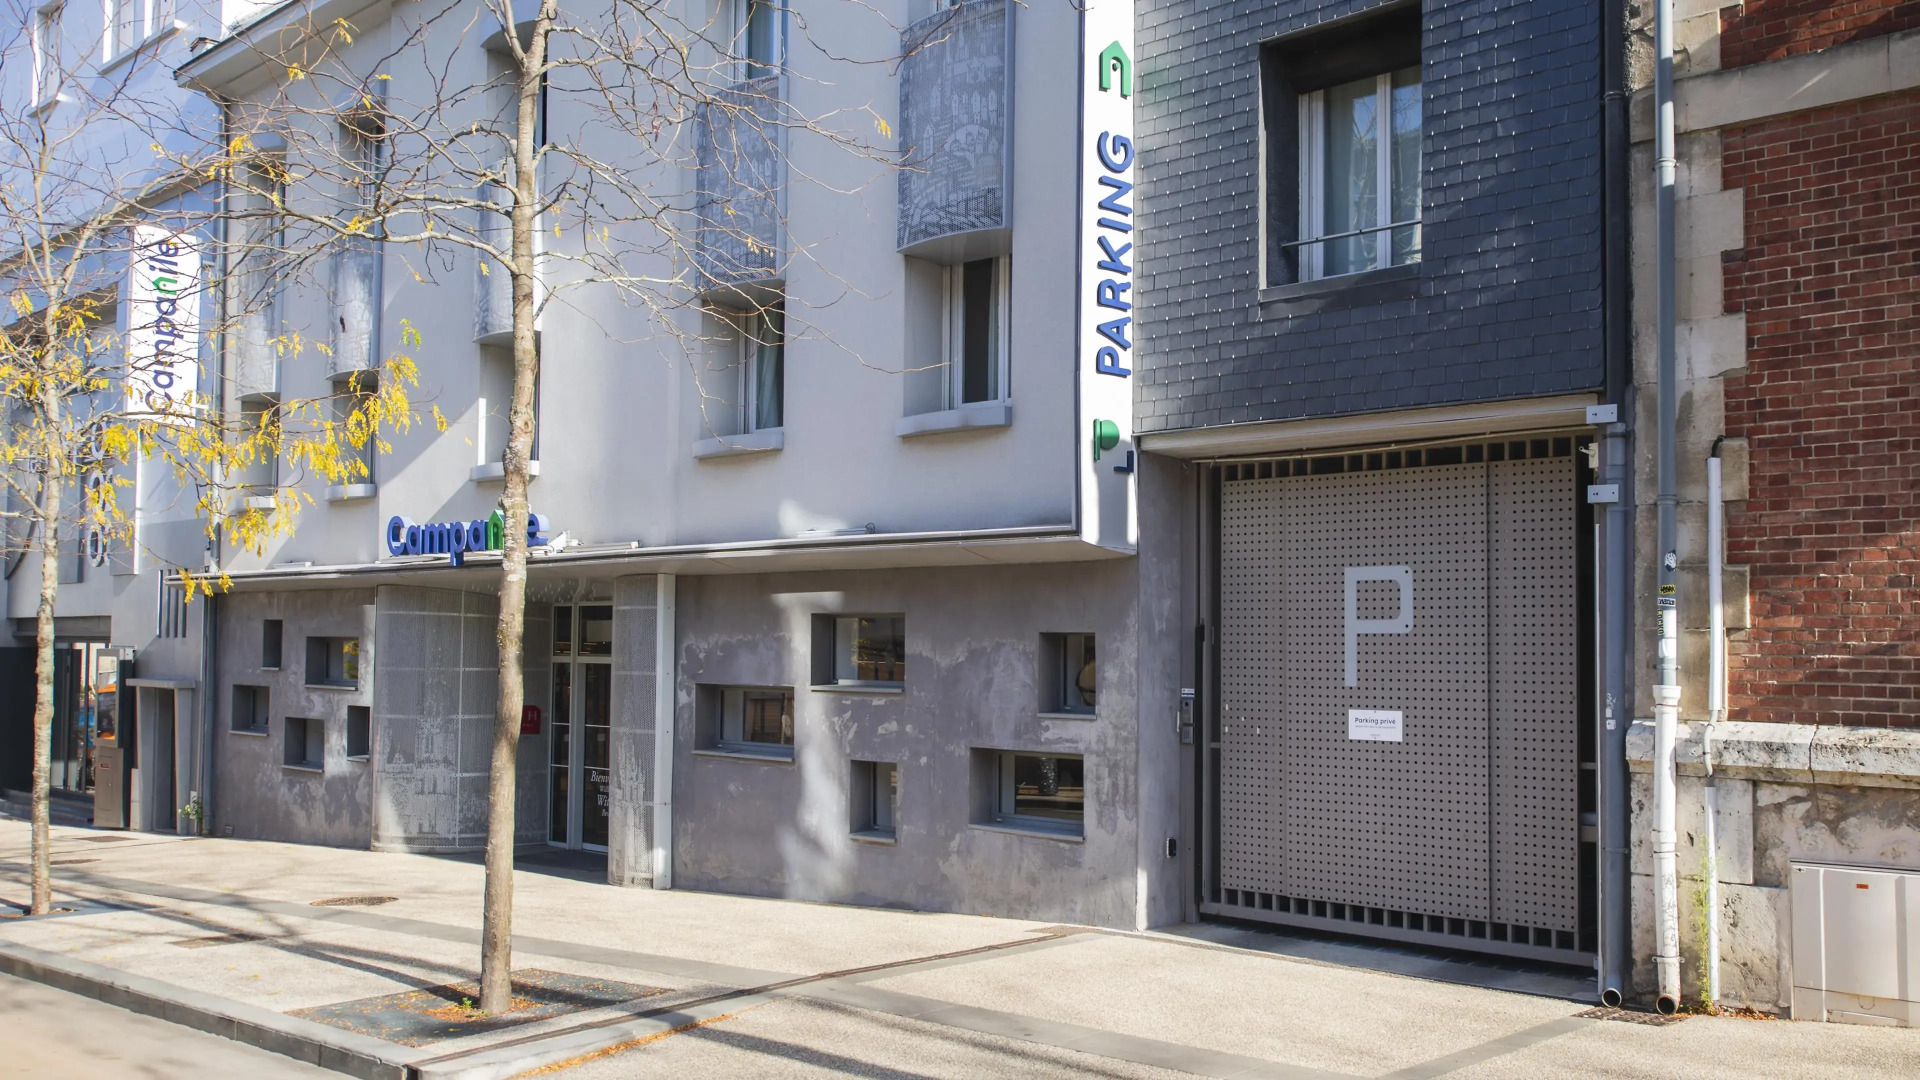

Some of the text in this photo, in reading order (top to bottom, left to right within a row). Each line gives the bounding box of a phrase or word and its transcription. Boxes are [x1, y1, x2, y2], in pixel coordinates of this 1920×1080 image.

[1097, 130, 1135, 378] PARKING
[145, 241, 184, 413] Campanile
[387, 508, 549, 566] Campane
[1344, 565, 1413, 687] P
[1354, 717, 1396, 725] Parking privé
